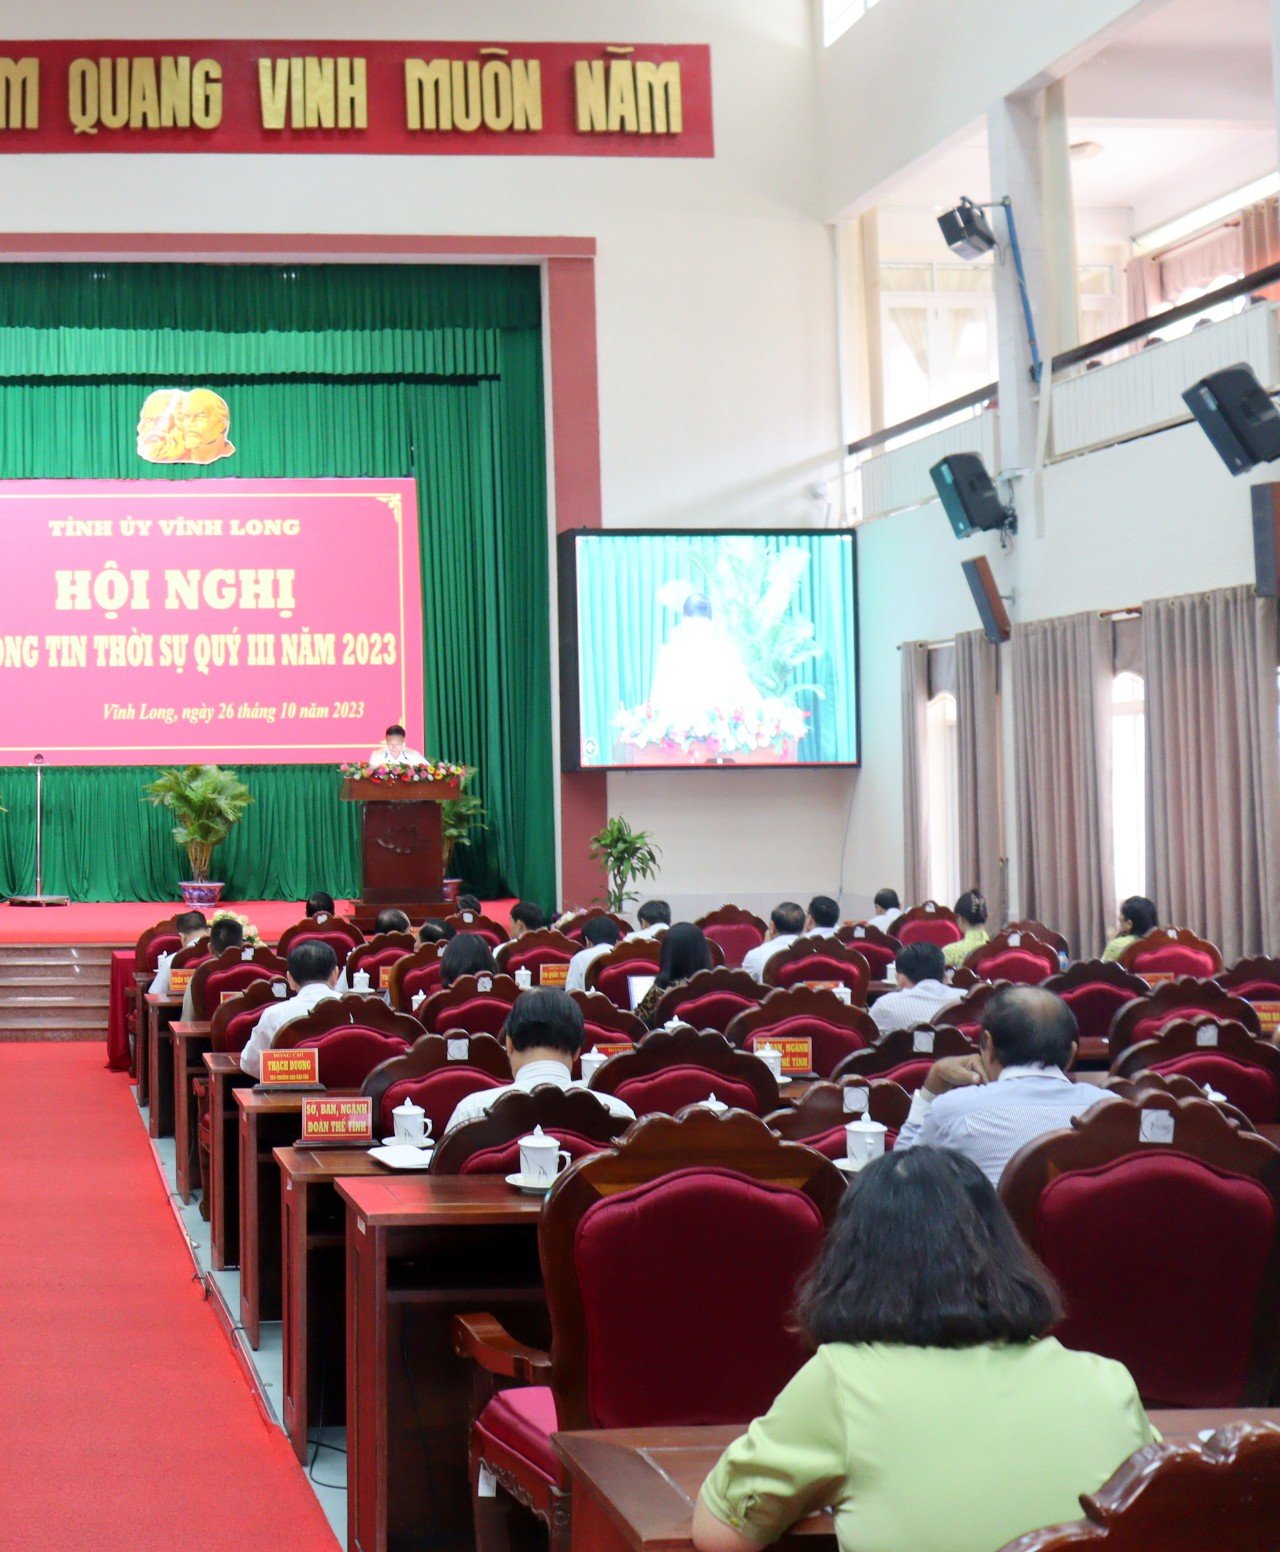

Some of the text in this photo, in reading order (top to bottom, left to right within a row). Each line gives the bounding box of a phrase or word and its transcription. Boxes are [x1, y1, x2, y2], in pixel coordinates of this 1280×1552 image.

[68, 56, 222, 134] QUANG
[258, 56, 368, 129] VINH
[405, 47, 543, 131] MUÔN
[574, 46, 683, 133] NĂM
[48, 516, 301, 536] TỈNH ỦY VĨNH LONG
[55, 560, 296, 620] HỘI NGHỊ
[45, 635, 87, 667] TIN
[93, 627, 154, 667] THỜI
[159, 634, 189, 674] SỰ
[194, 626, 241, 675] QUÝ
[247, 634, 275, 666] III
[281, 626, 336, 666] NĂM
[342, 632, 397, 666] 2023
[103, 701, 365, 724] Vĩnh Long, ngày 26 tháng 10 năm 2023
[267, 1061, 288, 1073] THẠCH
[320, 1104, 339, 1116] BAN,
[341, 1101, 368, 1114] NGÀNH
